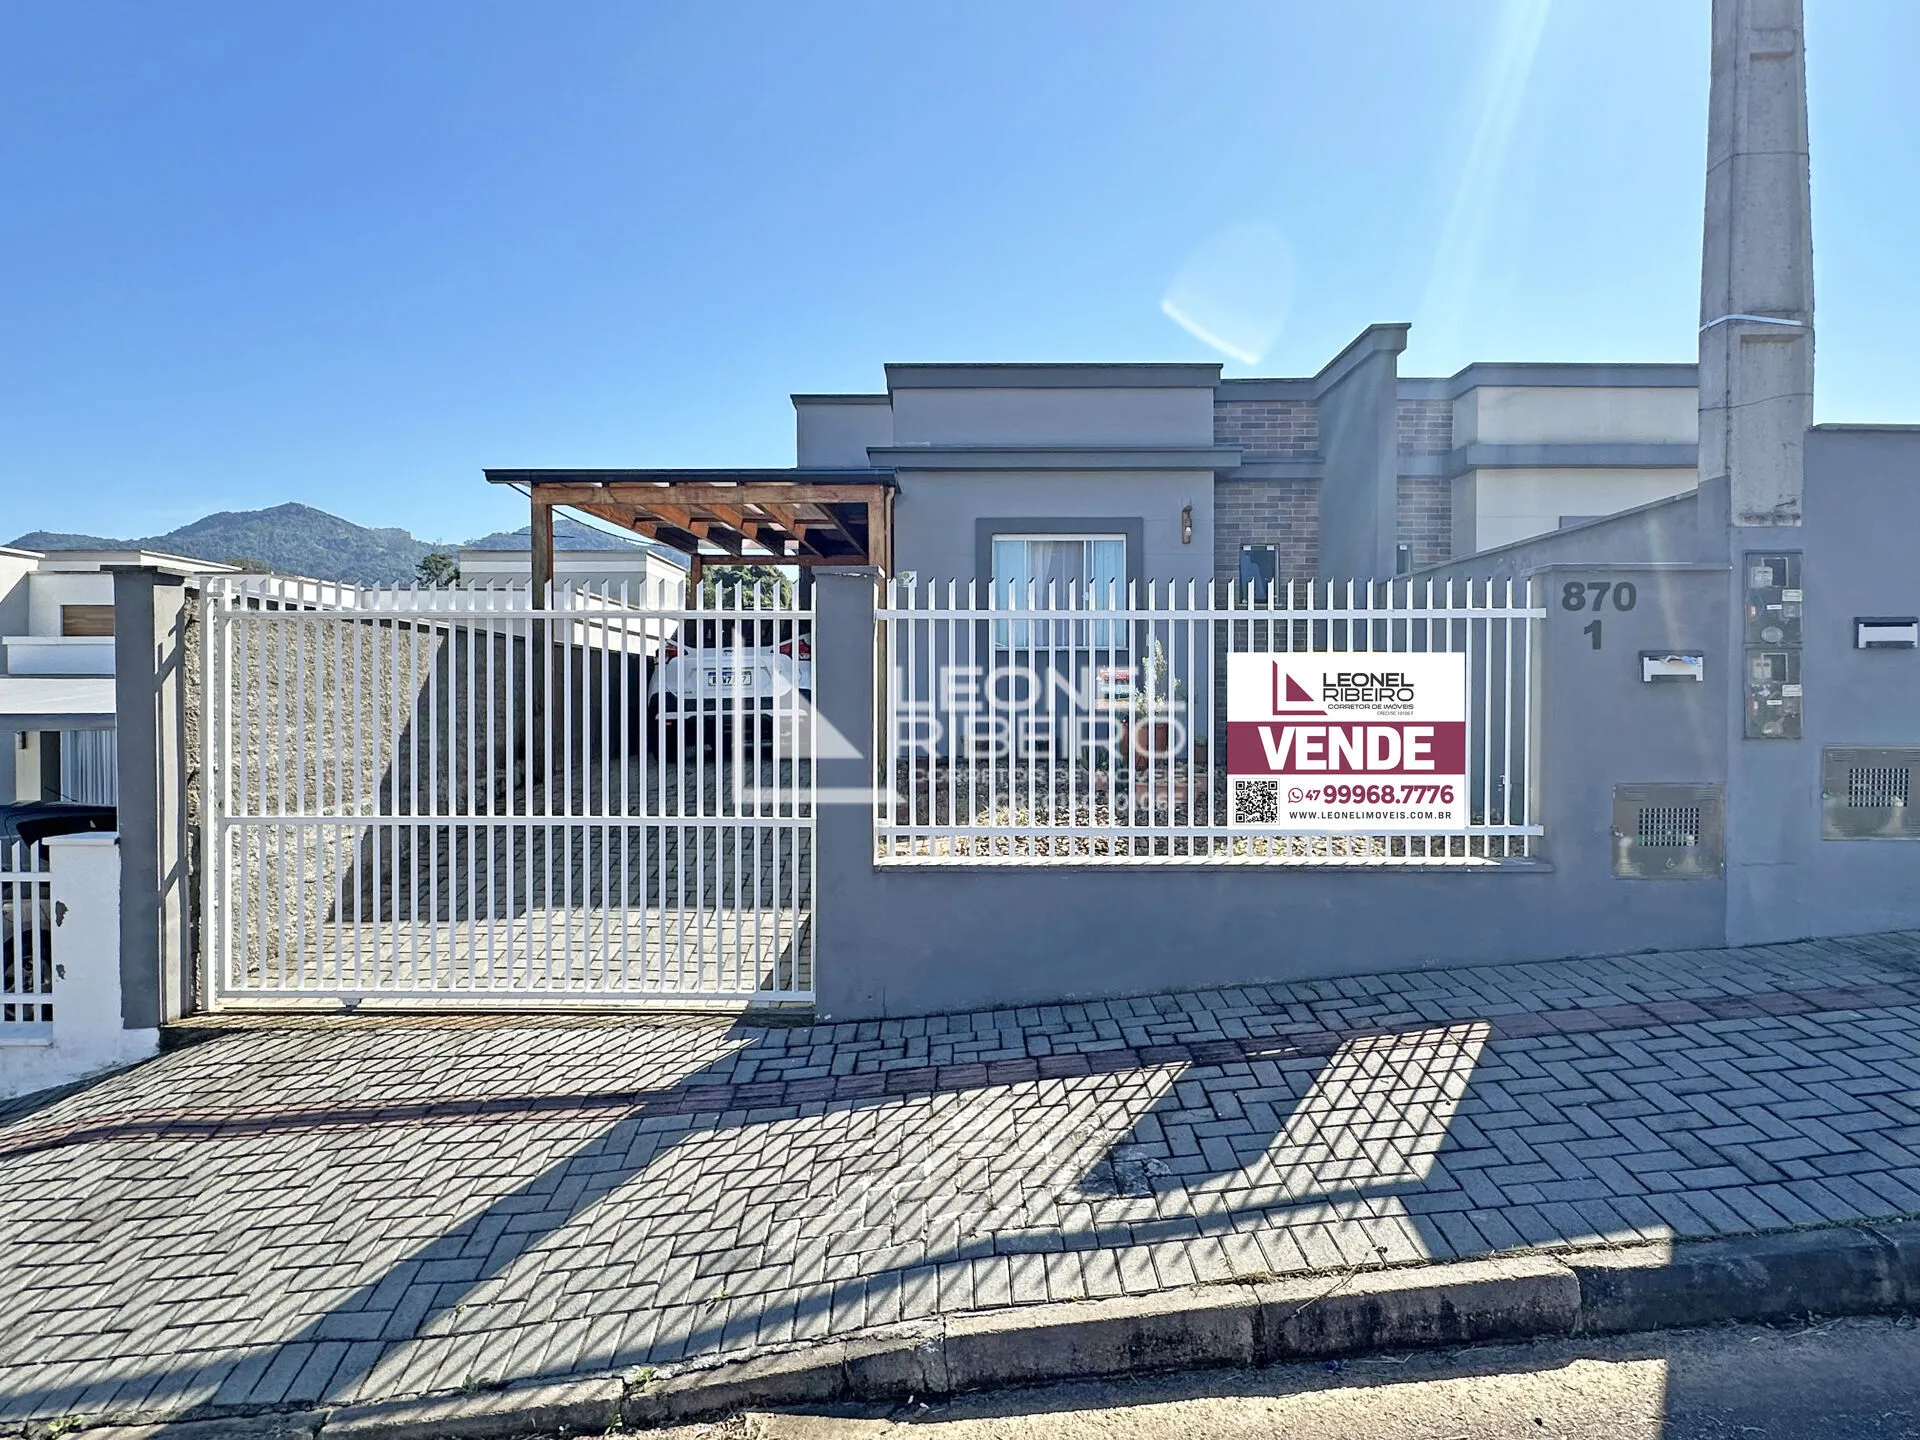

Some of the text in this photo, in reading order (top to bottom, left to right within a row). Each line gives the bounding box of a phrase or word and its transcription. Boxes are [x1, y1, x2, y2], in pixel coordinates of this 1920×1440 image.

[1562, 582, 1636, 611] 870
[1584, 620, 1601, 649] 1
[1323, 672, 1414, 687] LEONEL
[1323, 688, 1414, 701] RIBEIRO
[1257, 726, 1435, 770] VENDE
[1305, 784, 1454, 805] 47 99968.7776
[1289, 811, 1452, 820] WWW.LEONELIMOVEIS.COM.BR
